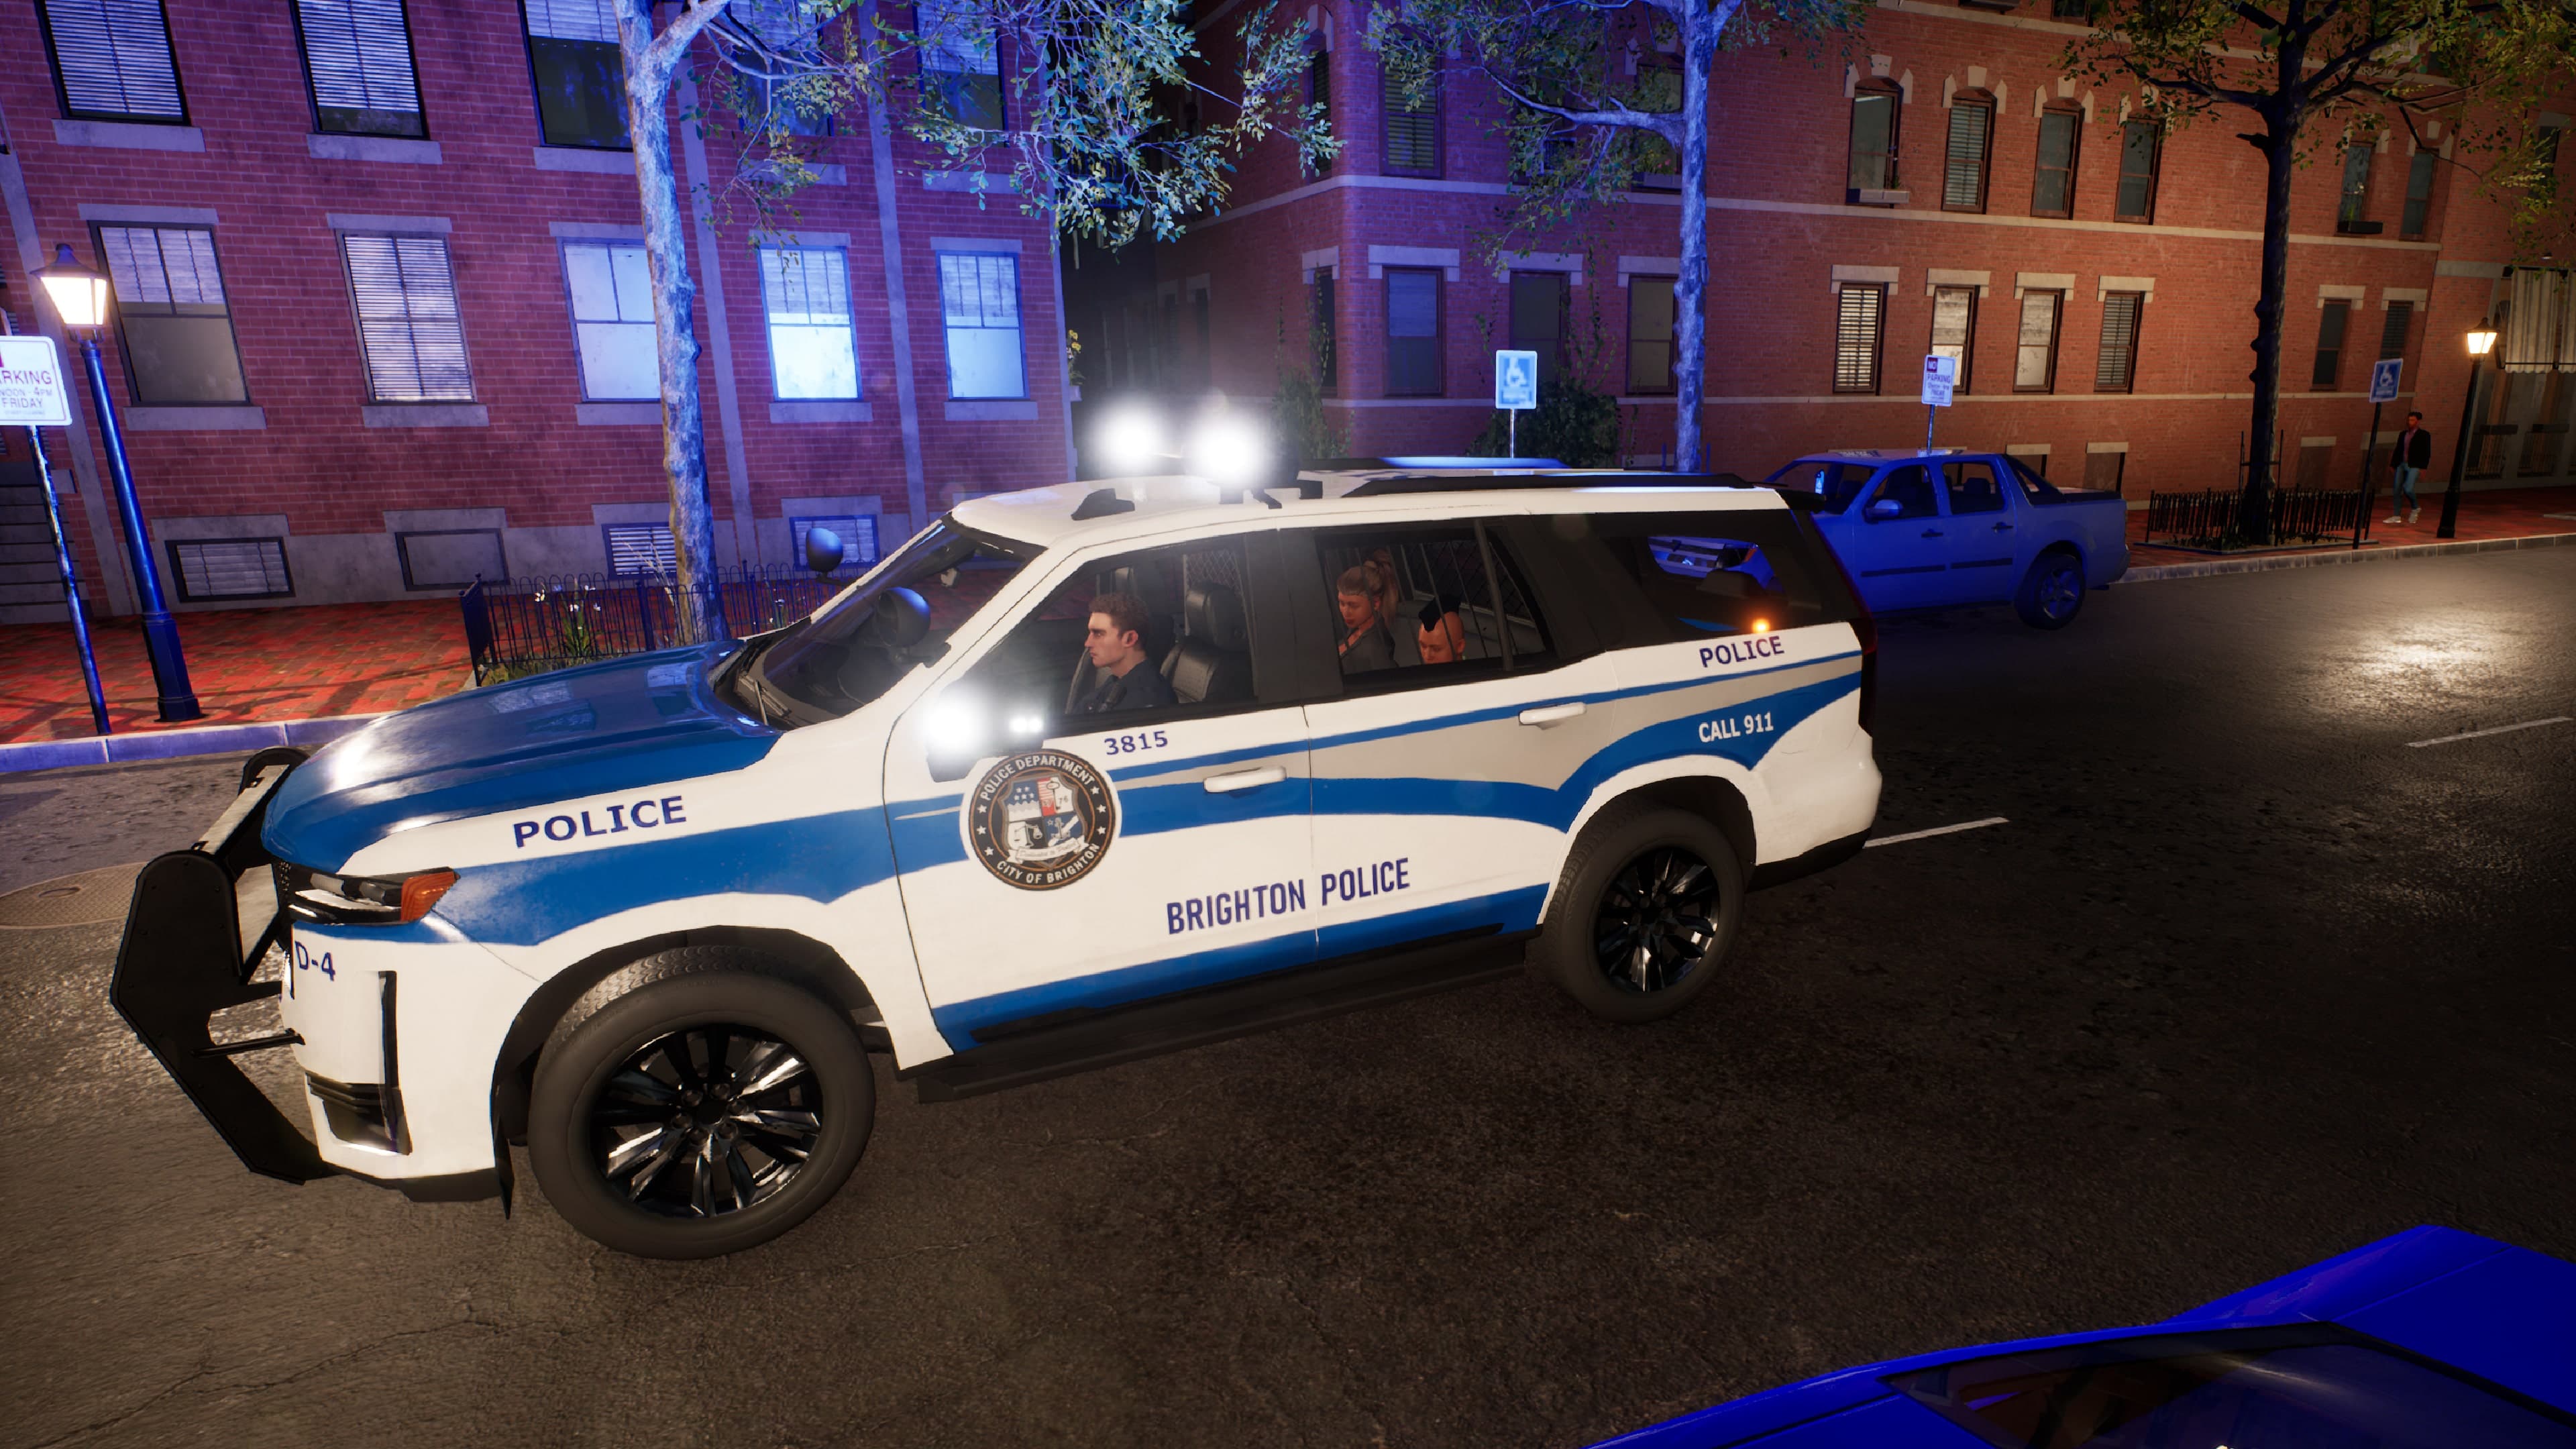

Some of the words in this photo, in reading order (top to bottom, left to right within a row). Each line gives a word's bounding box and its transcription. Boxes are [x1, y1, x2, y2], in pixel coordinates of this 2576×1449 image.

[0, 370, 52, 384] RKING
[1, 398, 42, 408] FRIDAY
[1699, 636, 1784, 667] POLICE
[1104, 731, 1168, 755] 3815
[1699, 718, 1741, 743] CALL
[1744, 712, 1774, 735] 911
[979, 763, 1016, 800] POLICE
[1014, 755, 1095, 786] DEPARTMENT
[513, 796, 687, 849] POLICE
[996, 861, 1023, 880] CITY
[1026, 873, 1042, 883] OF
[1046, 843, 1100, 883] BRIGHTON
[1167, 879, 1306, 934] BRIGHTON
[1322, 857, 1410, 906] POLICE
[295, 941, 335, 981] D-4
